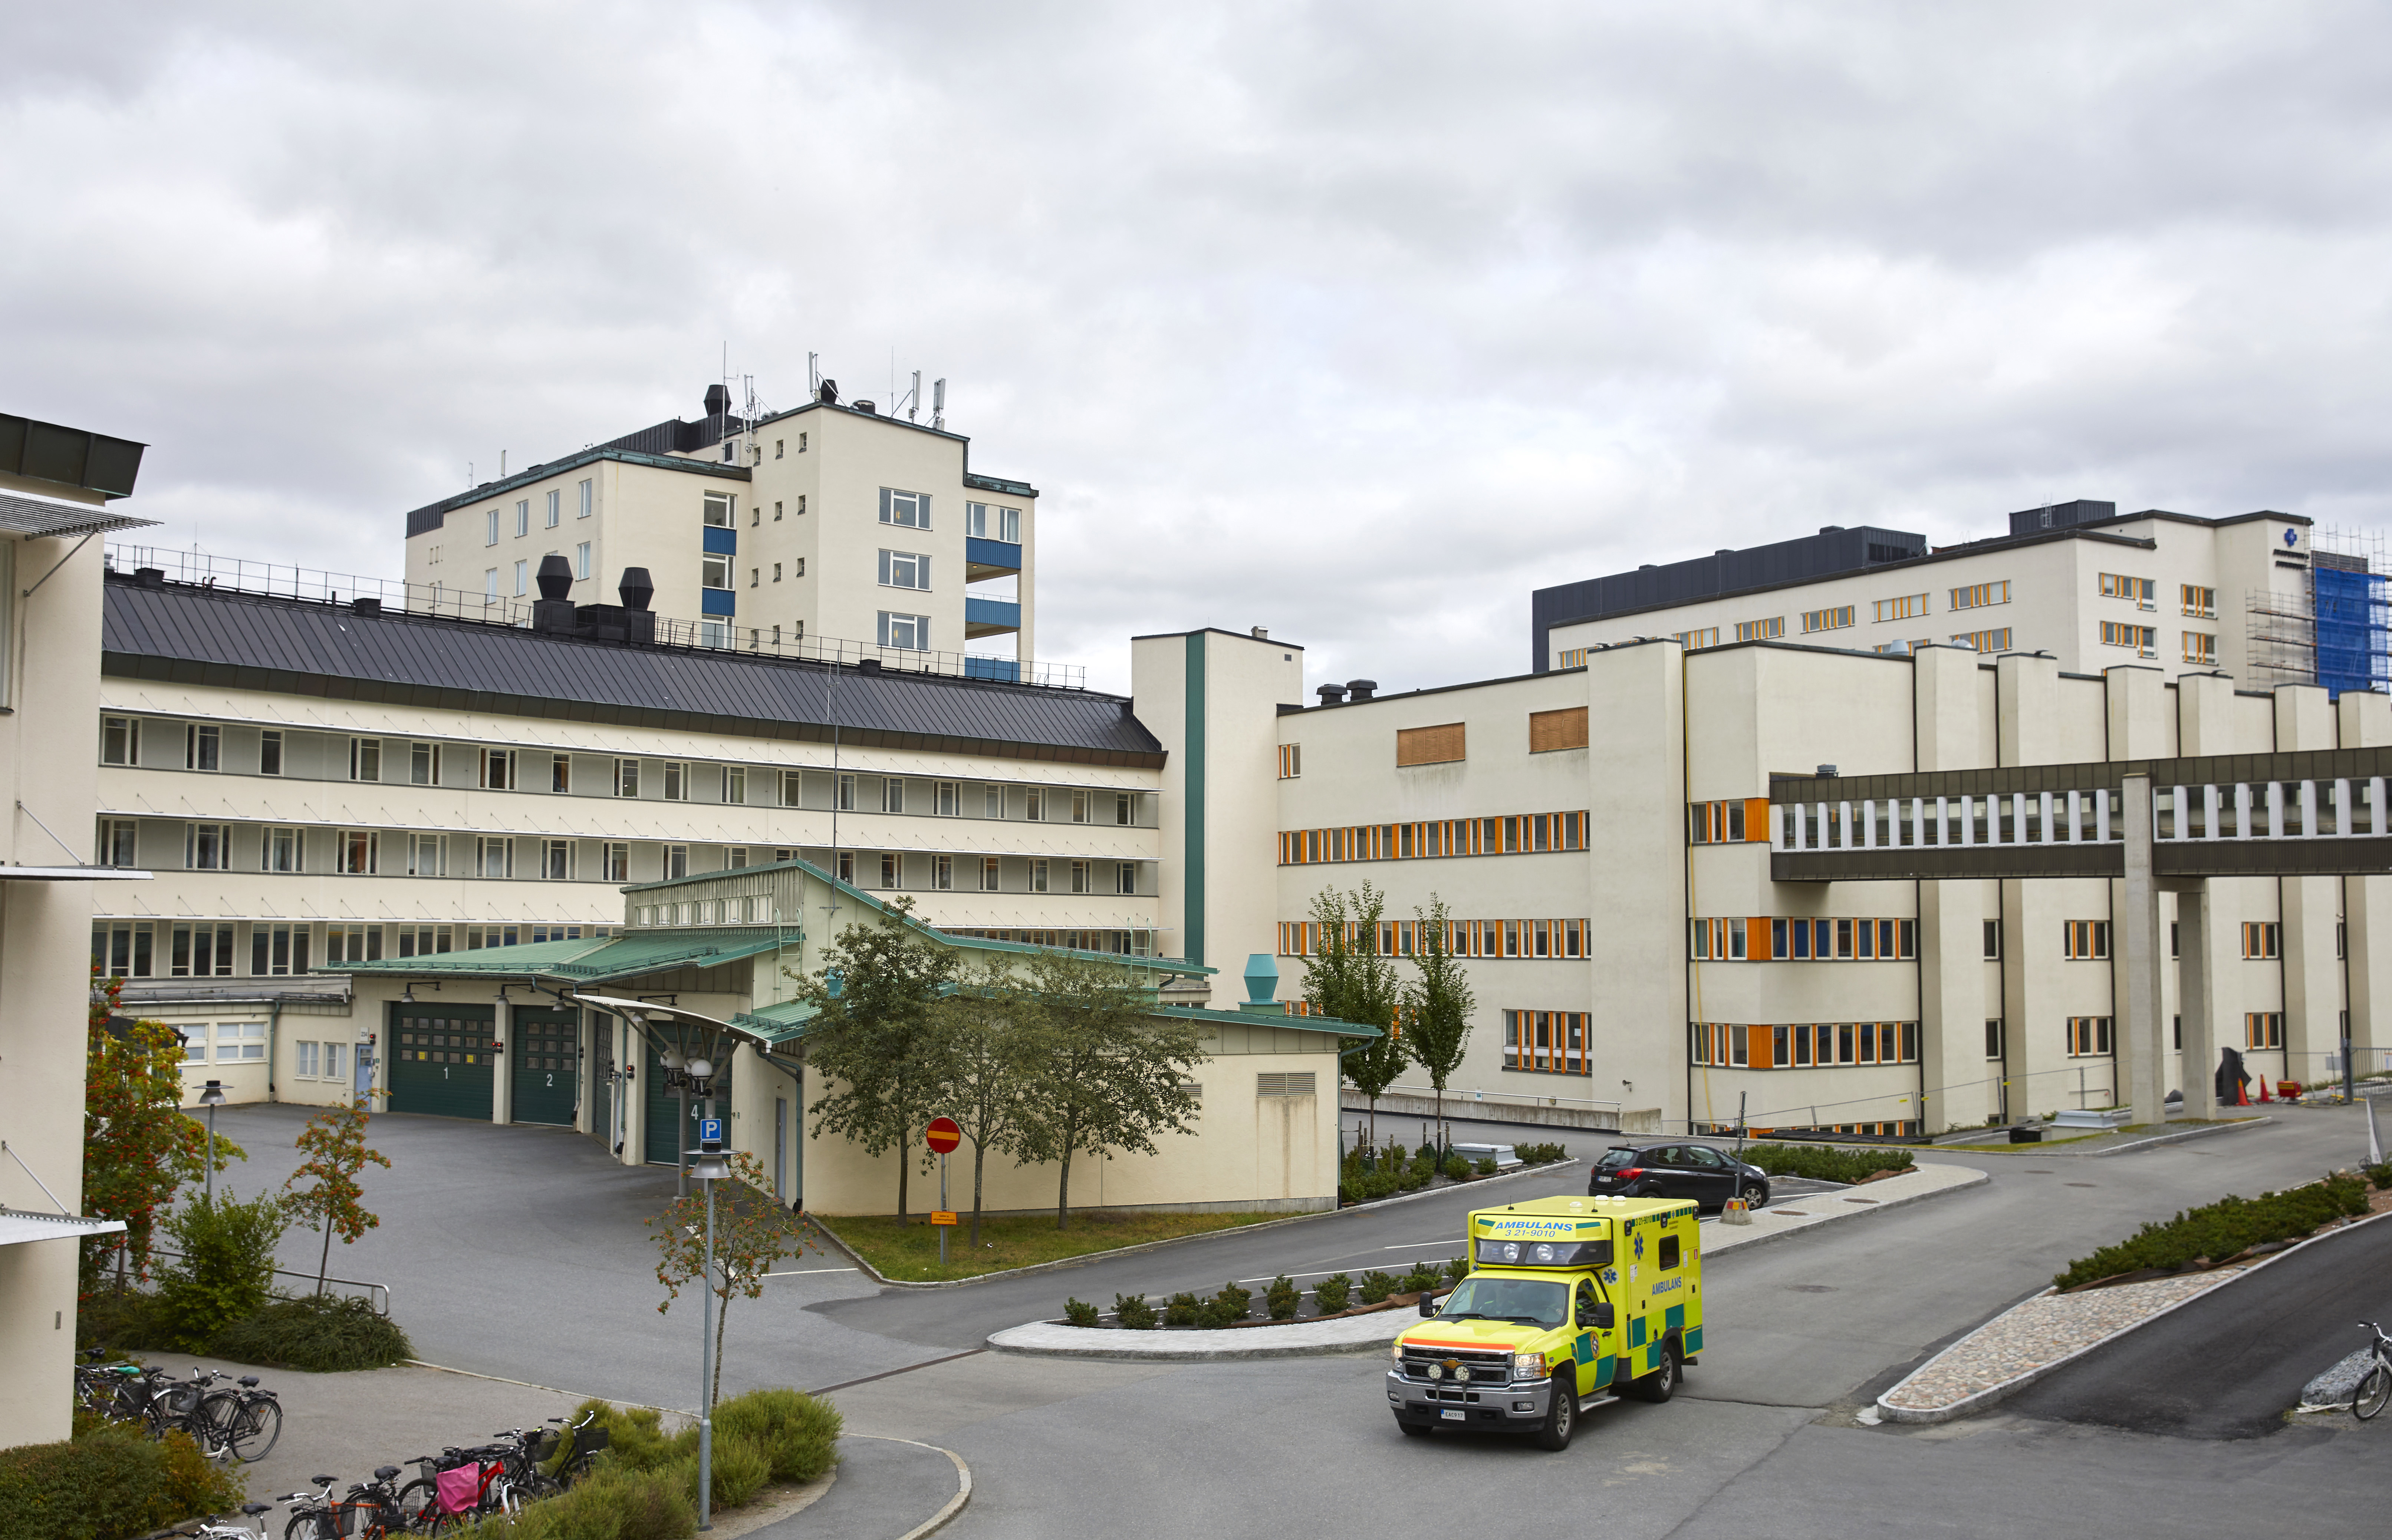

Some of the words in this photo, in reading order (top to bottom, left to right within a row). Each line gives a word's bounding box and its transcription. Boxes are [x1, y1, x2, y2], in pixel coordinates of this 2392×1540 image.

[444, 1067, 448, 1079] 1
[547, 1074, 553, 1086] 2
[691, 1105, 698, 1120] 4
[706, 1121, 717, 1137] P
[1495, 1221, 1573, 1231] AMBULANS
[1639, 1215, 1652, 1225] 21-9010
[1652, 1276, 1681, 1296] AMBULANS
